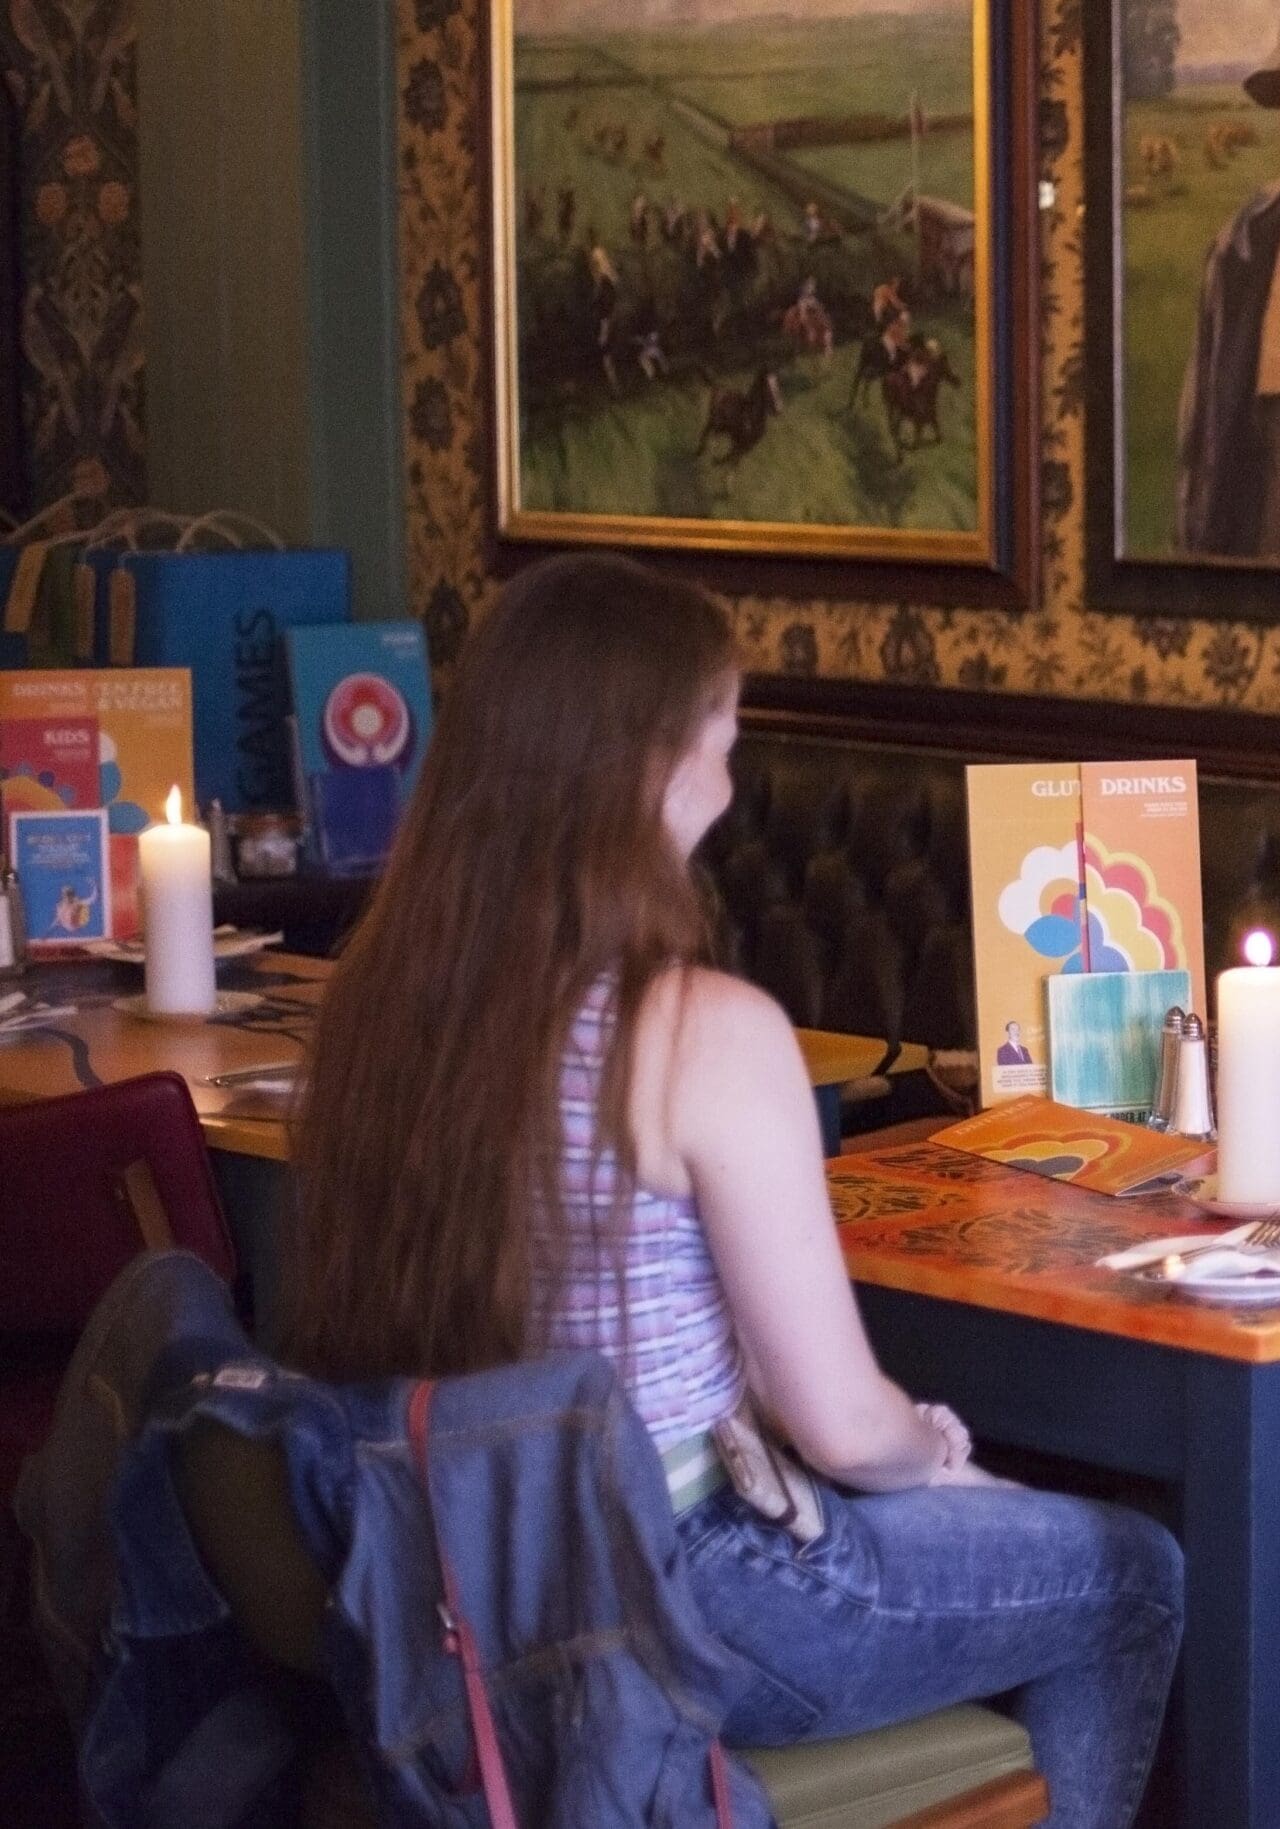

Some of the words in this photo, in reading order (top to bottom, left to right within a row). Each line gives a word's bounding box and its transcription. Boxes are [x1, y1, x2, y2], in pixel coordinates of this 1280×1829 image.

[234, 607, 276, 806] GAMES
[43, 728, 91, 746] KIDS
[1101, 776, 1186, 796] DRINKS
